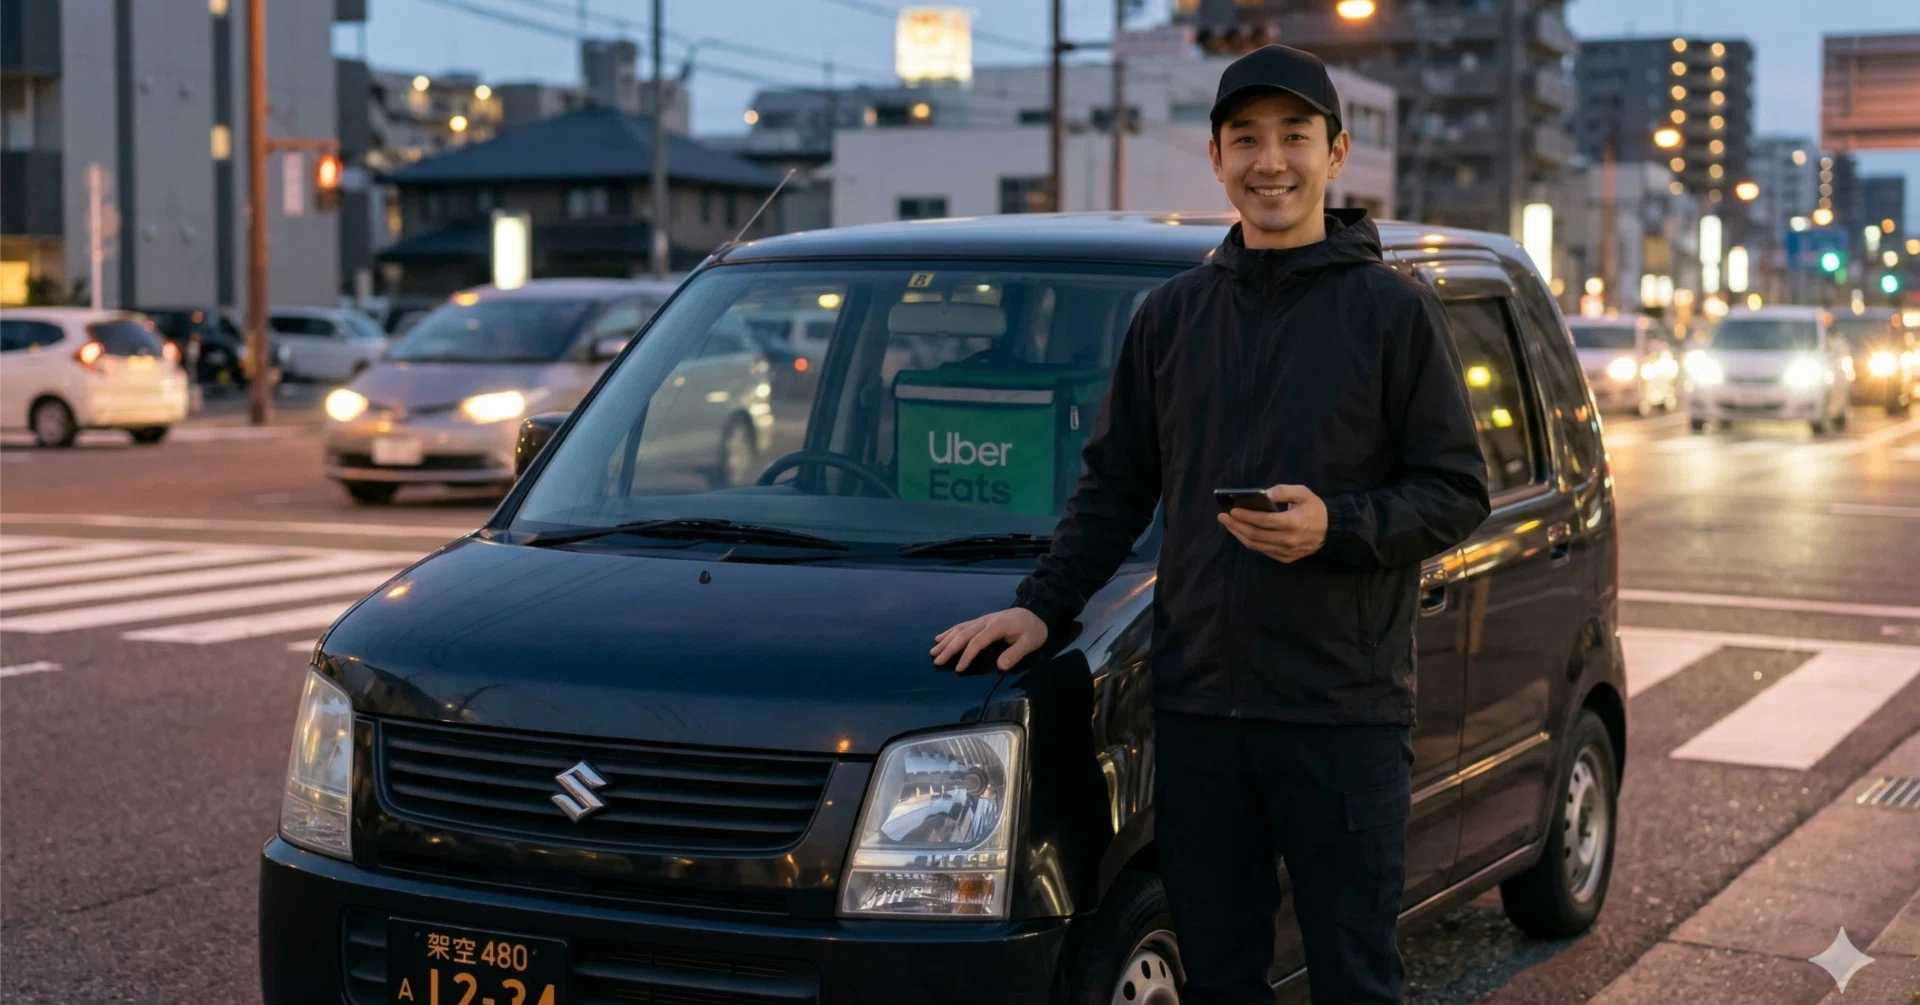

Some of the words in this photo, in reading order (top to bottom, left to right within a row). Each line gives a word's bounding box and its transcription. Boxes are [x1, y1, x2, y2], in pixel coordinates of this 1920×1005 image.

[928, 430, 1013, 467] Uber
[929, 468, 1012, 505] Eats
[398, 978, 414, 1002] A
